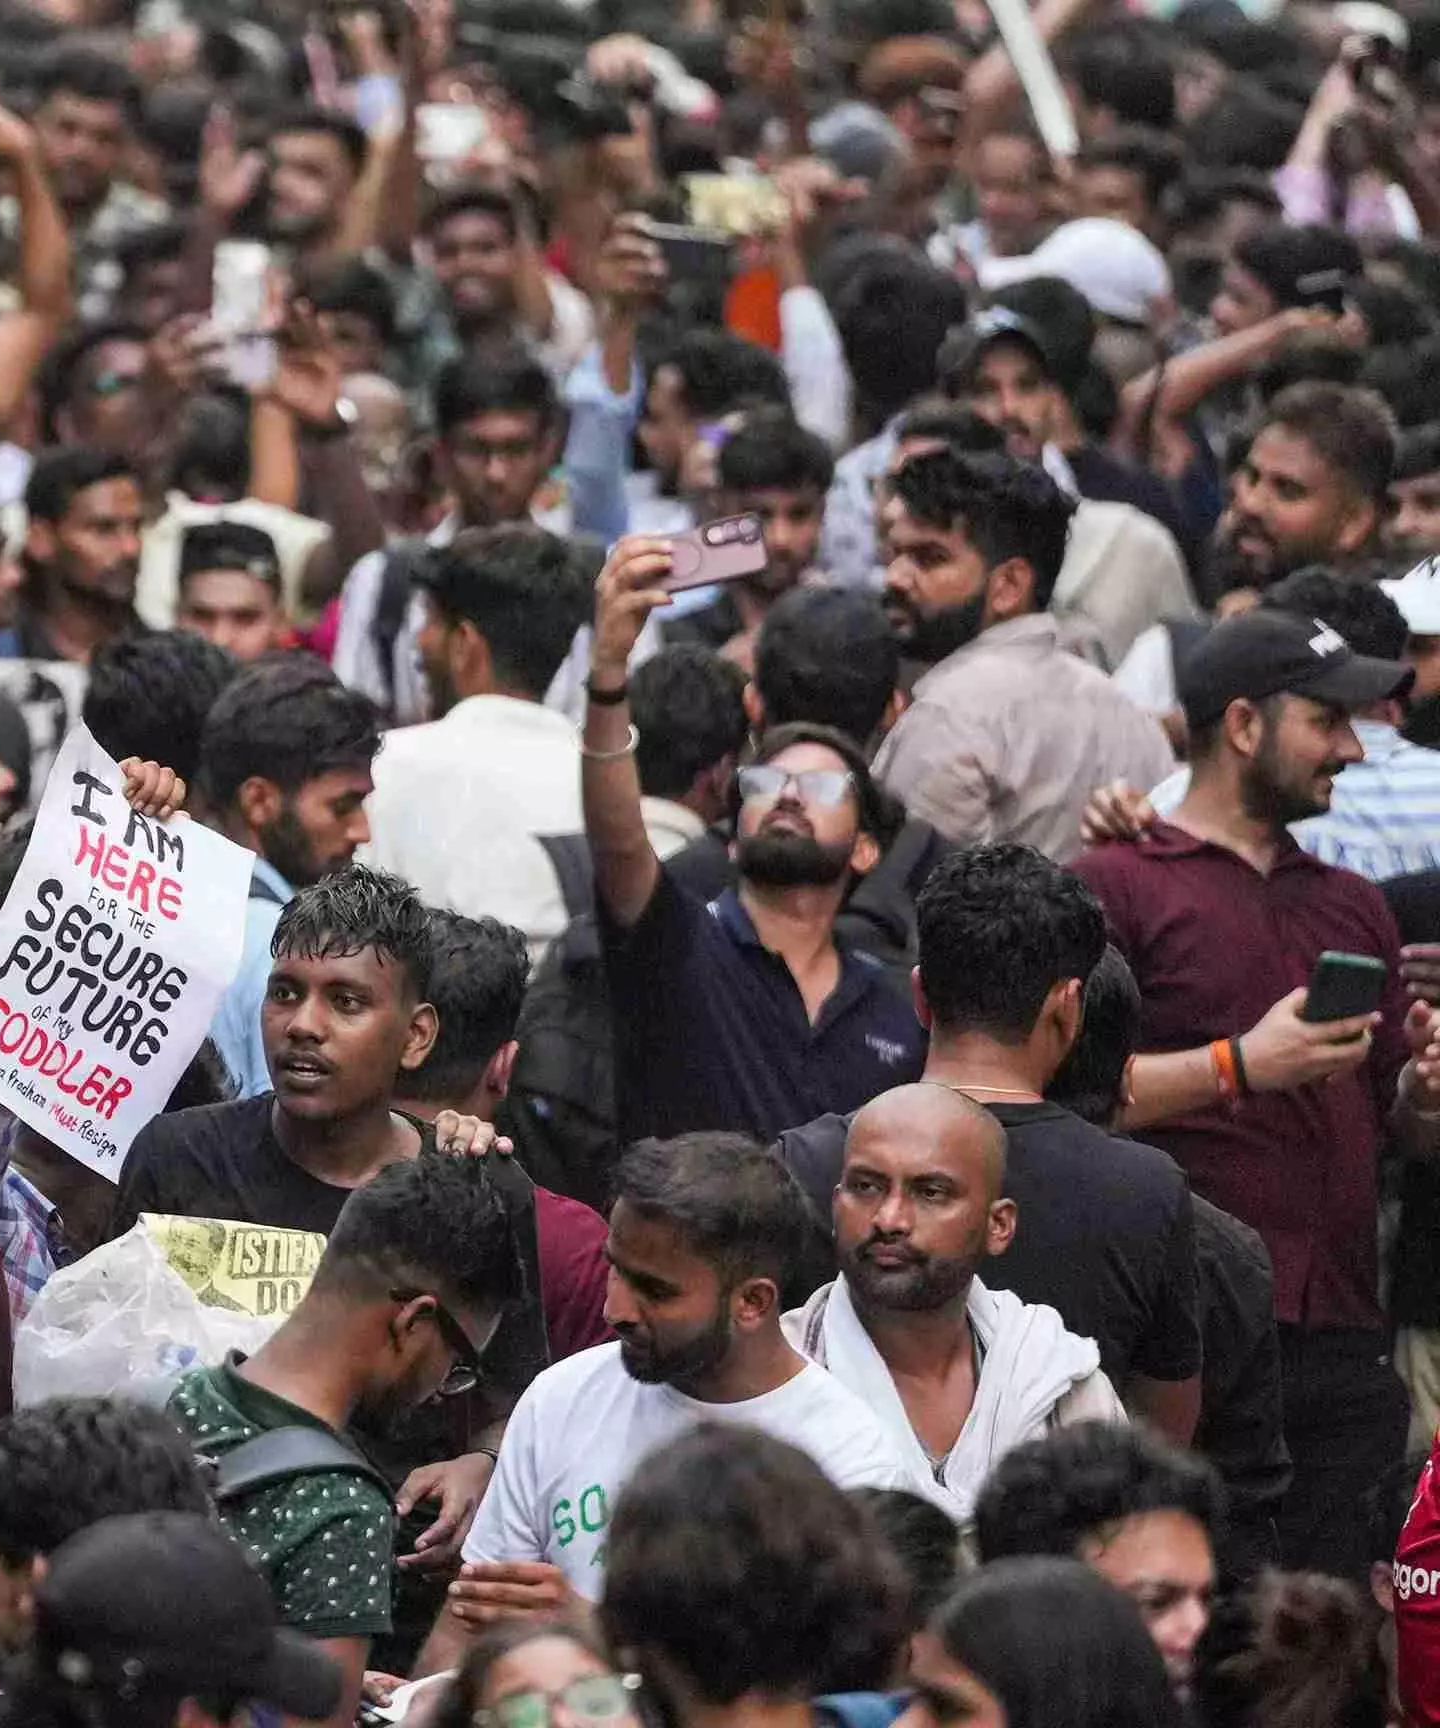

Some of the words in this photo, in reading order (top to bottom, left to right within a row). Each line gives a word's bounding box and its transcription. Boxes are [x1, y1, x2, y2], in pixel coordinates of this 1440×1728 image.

[71, 771, 113, 826] I
[123, 808, 184, 872] AM
[74, 824, 183, 920] HERE
[25, 878, 188, 1012] SECURE
[127, 907, 157, 939] THE
[78, 1119, 118, 1158] Resign
[257, 1280, 301, 1315] DO
